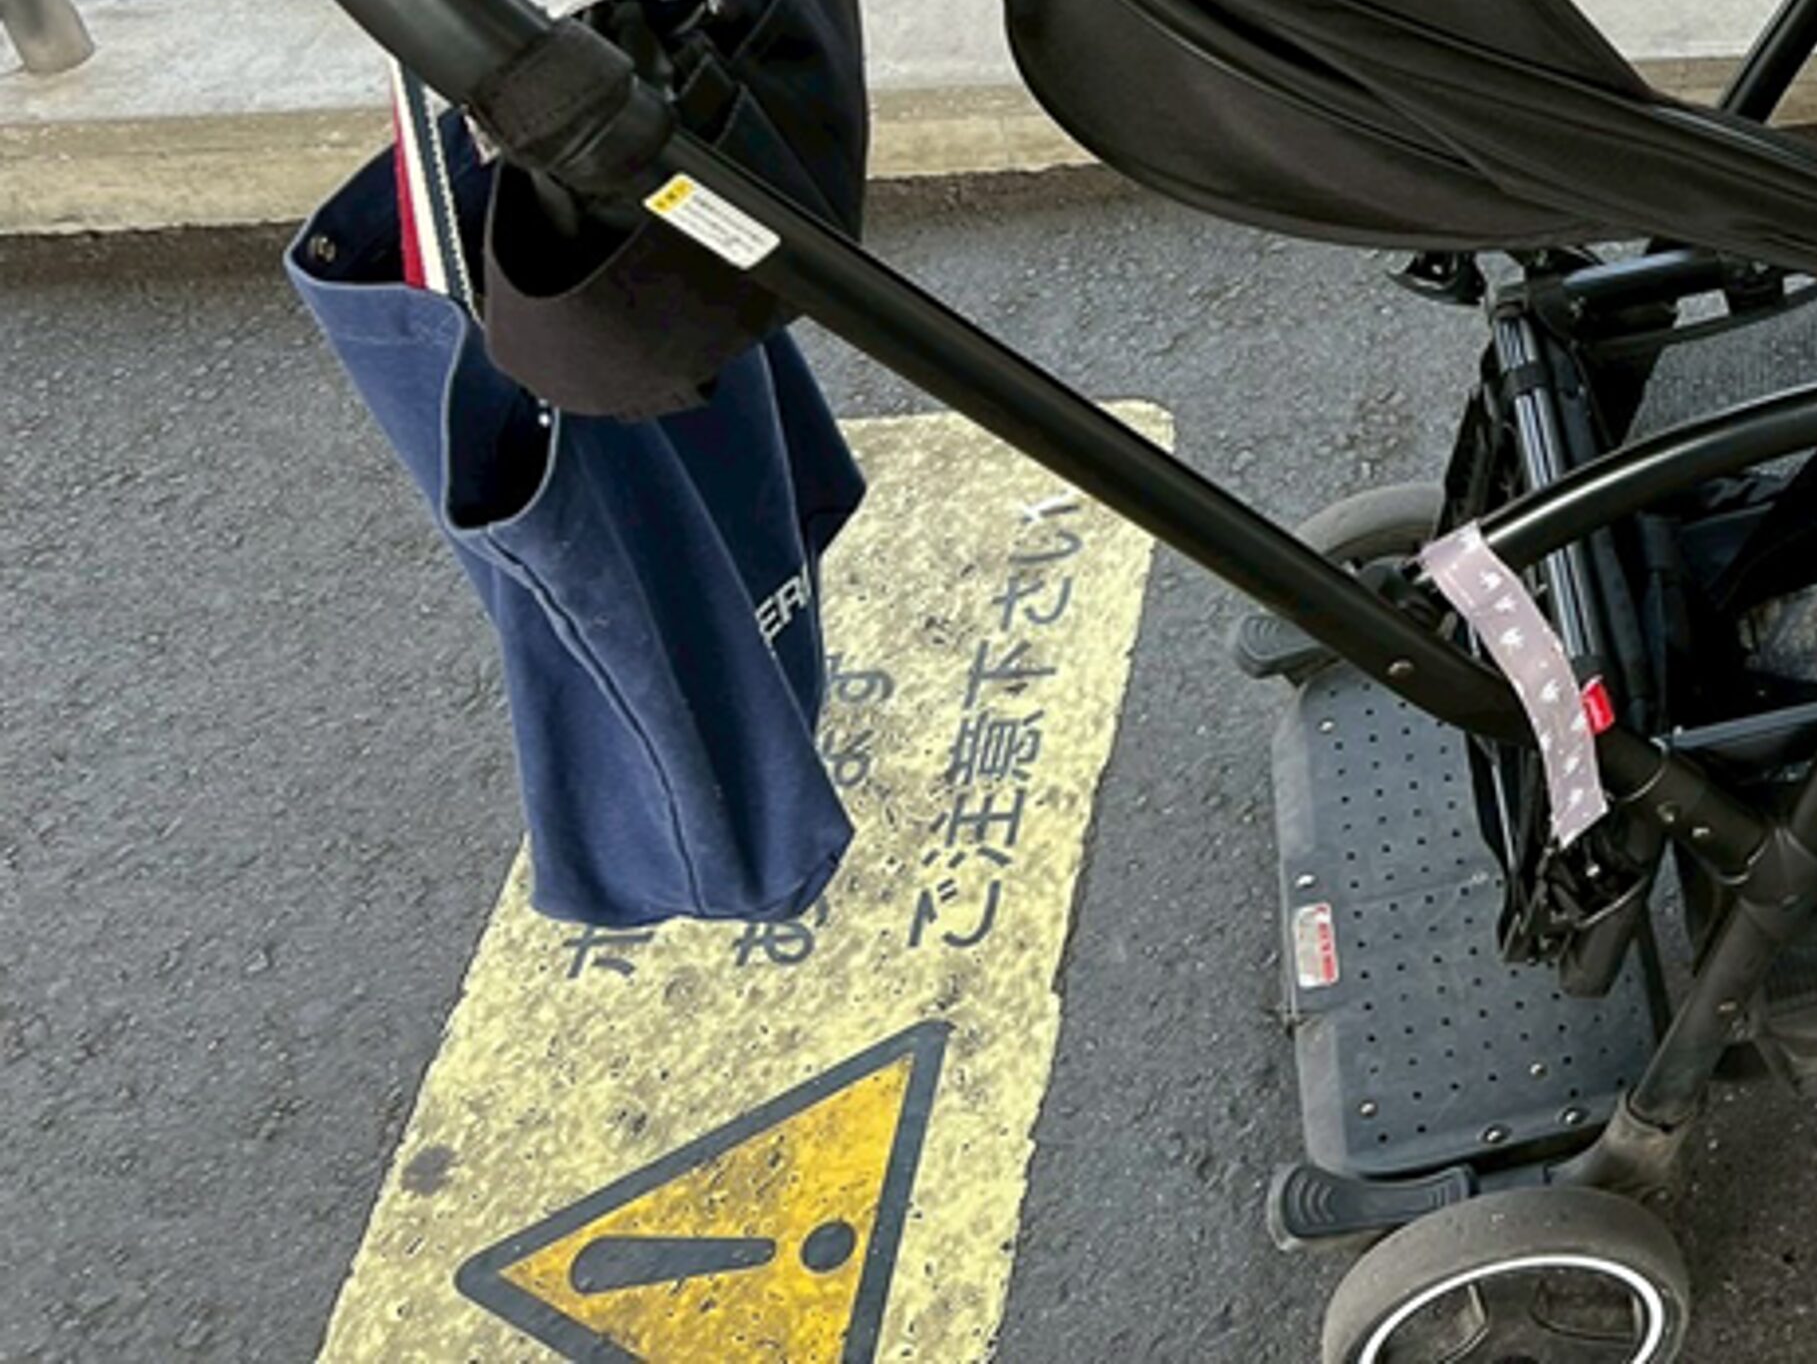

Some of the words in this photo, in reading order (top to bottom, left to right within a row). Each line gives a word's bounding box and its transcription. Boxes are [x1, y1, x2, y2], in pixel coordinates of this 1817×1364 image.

[908, 493, 1082, 947] ご注意下さい
